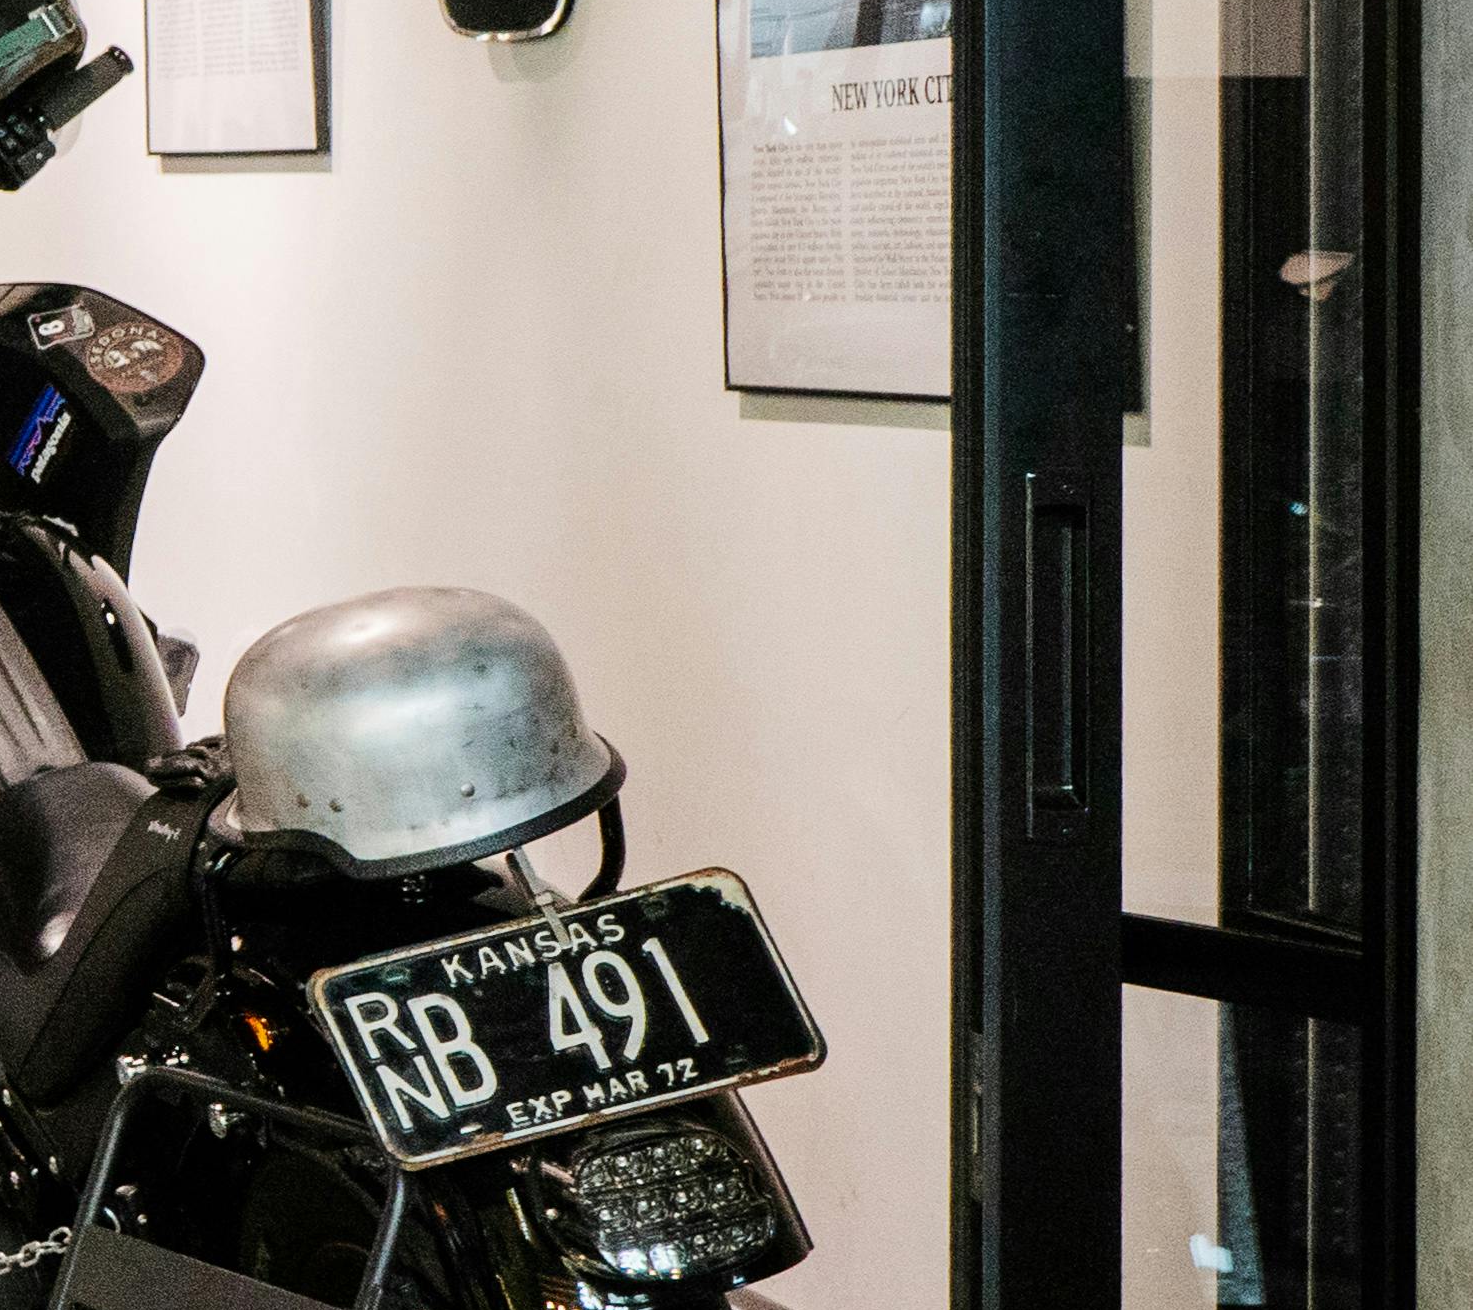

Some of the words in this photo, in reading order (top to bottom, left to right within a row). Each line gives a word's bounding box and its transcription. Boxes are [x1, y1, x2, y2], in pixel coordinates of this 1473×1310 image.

[832, 81, 869, 112] NEW
[873, 77, 920, 109] YORK
[30, 411, 72, 484] patagonia
[439, 913, 626, 987] KANSAS
[547, 936, 710, 1072] 491
[505, 1089, 573, 1127] EXP
[582, 1069, 649, 1108] MAR
[656, 1057, 700, 1087] 72
